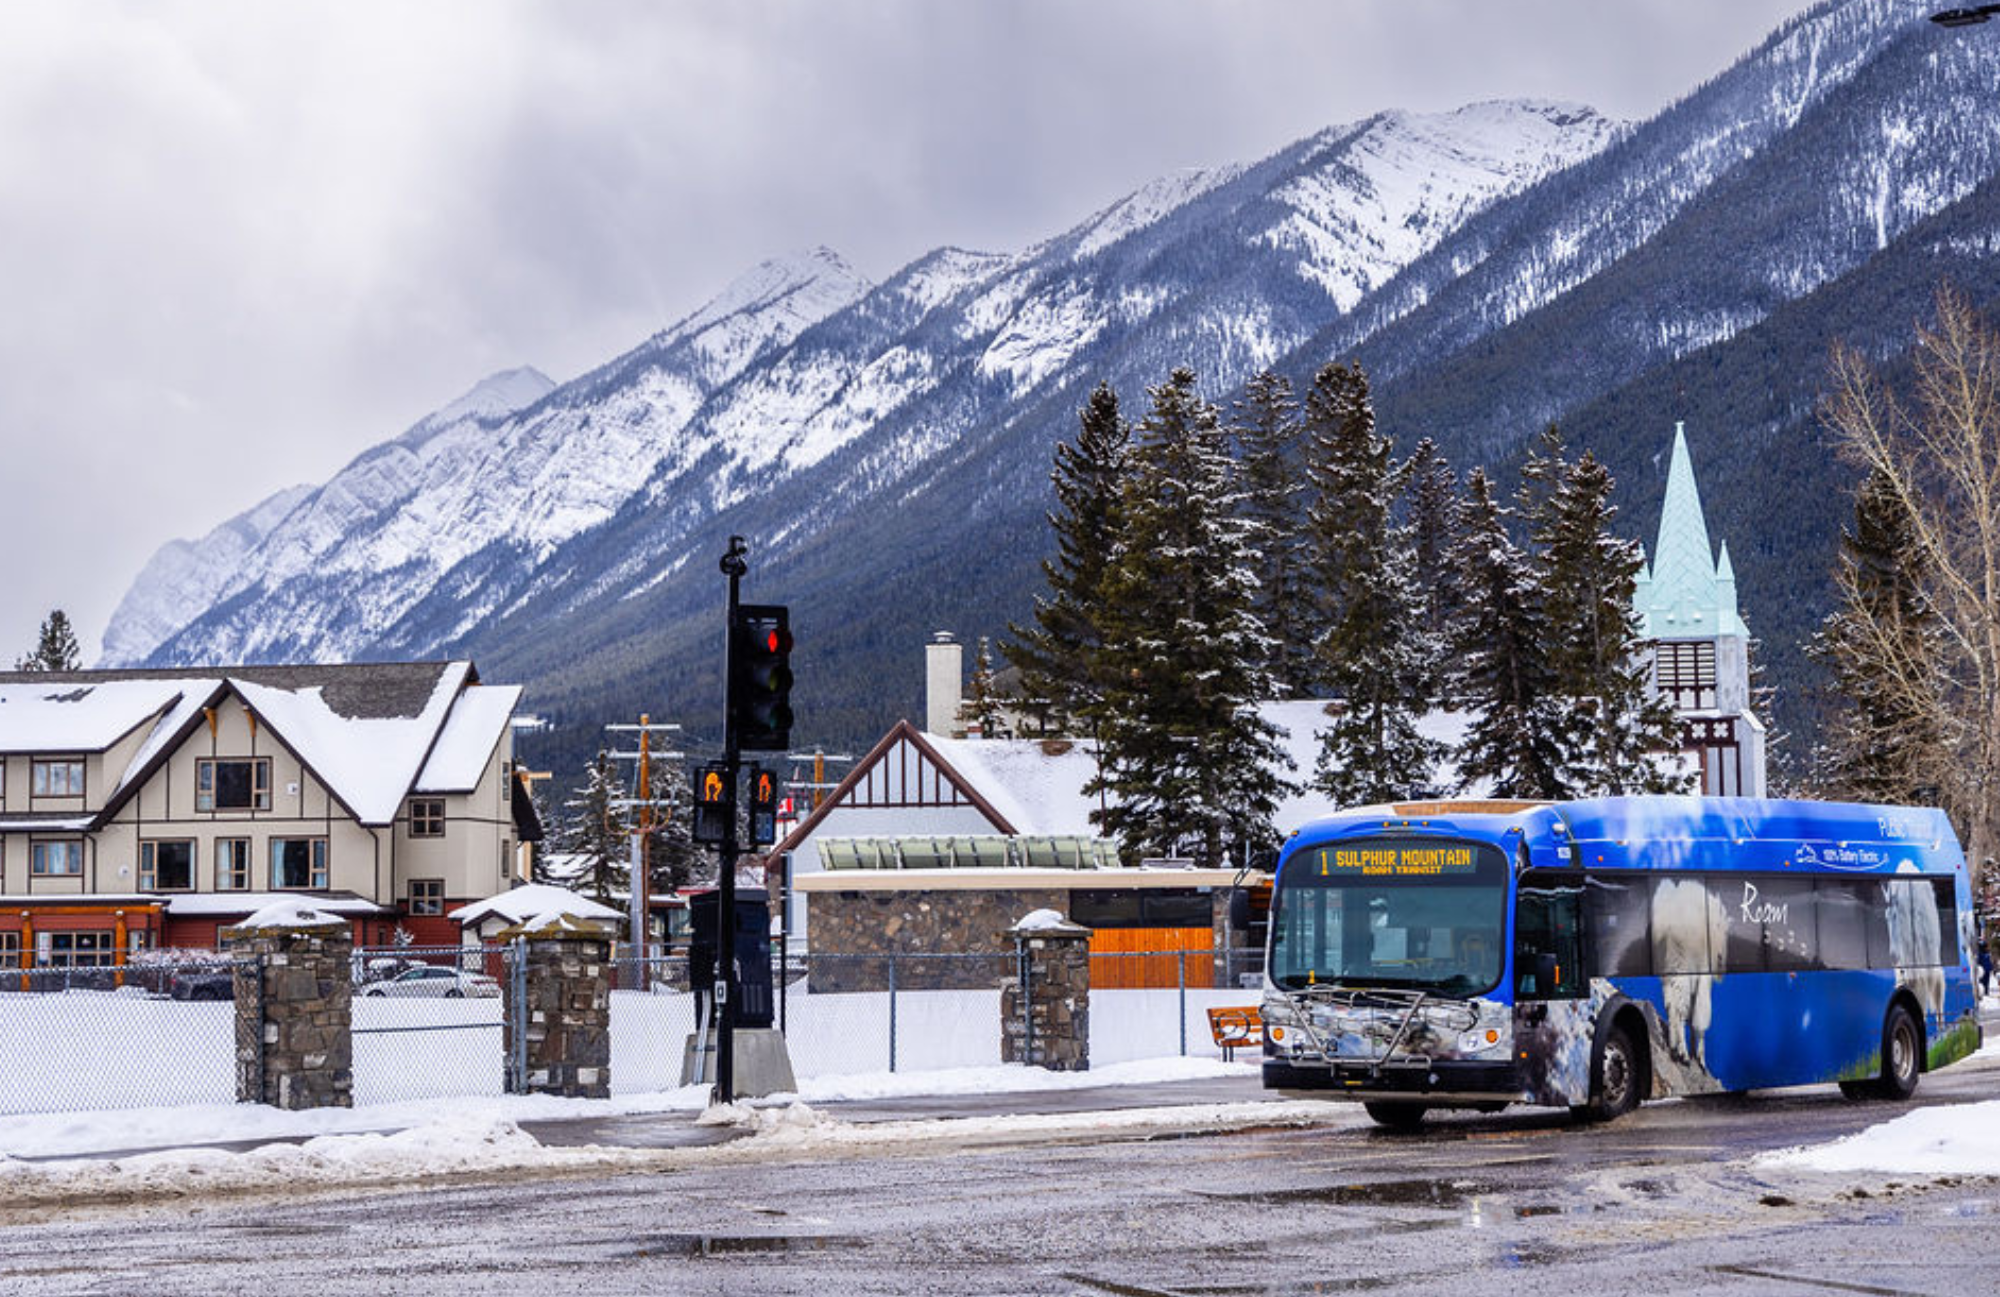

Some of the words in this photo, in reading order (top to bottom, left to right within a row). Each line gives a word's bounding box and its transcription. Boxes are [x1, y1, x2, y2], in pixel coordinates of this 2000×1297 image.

[1320, 850, 1329, 876] 1
[1336, 850, 1397, 867] SULPHUR
[1401, 849, 1471, 866] MOUNTAIN
[1740, 881, 1788, 924] Roam
